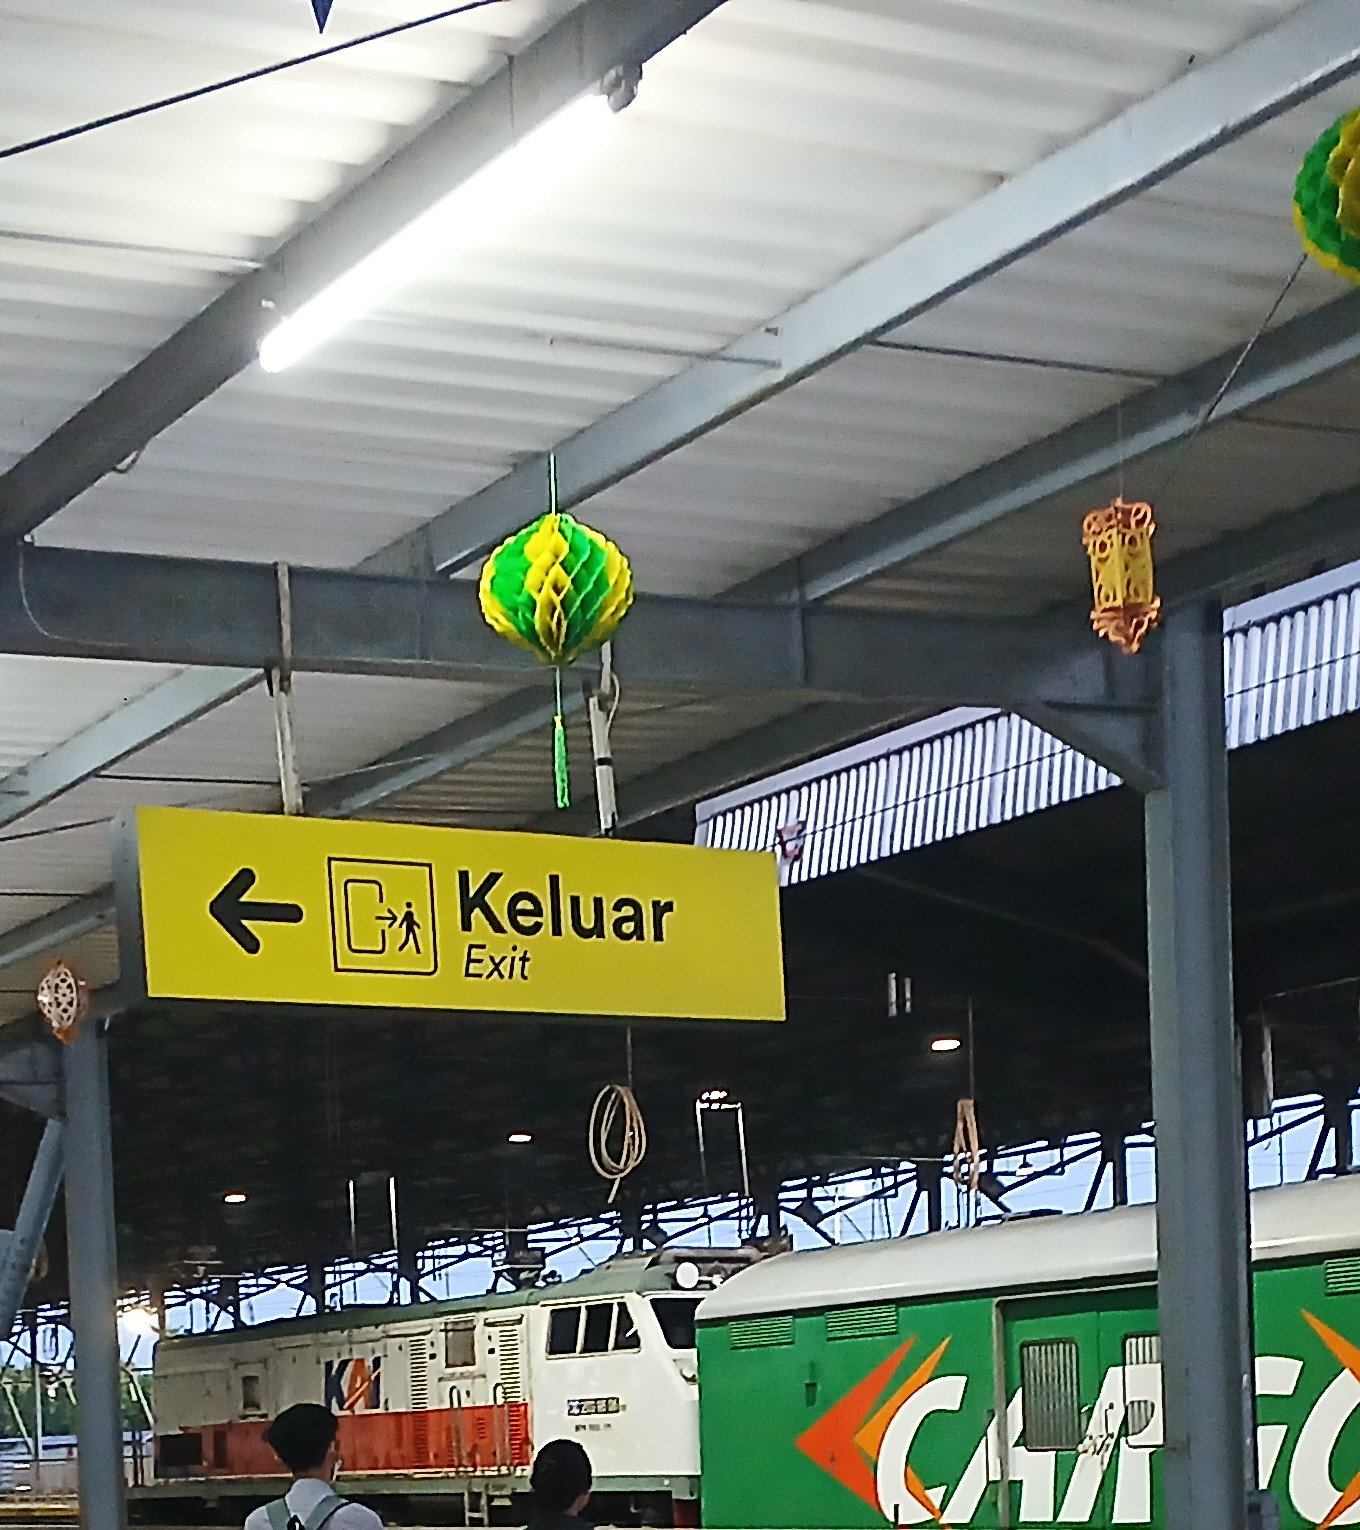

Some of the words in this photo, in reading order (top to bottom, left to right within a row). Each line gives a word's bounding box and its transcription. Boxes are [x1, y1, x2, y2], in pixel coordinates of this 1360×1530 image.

[457, 869, 674, 942] Keluar
[464, 943, 531, 980] Exit
[324, 1356, 382, 1411] KAI
